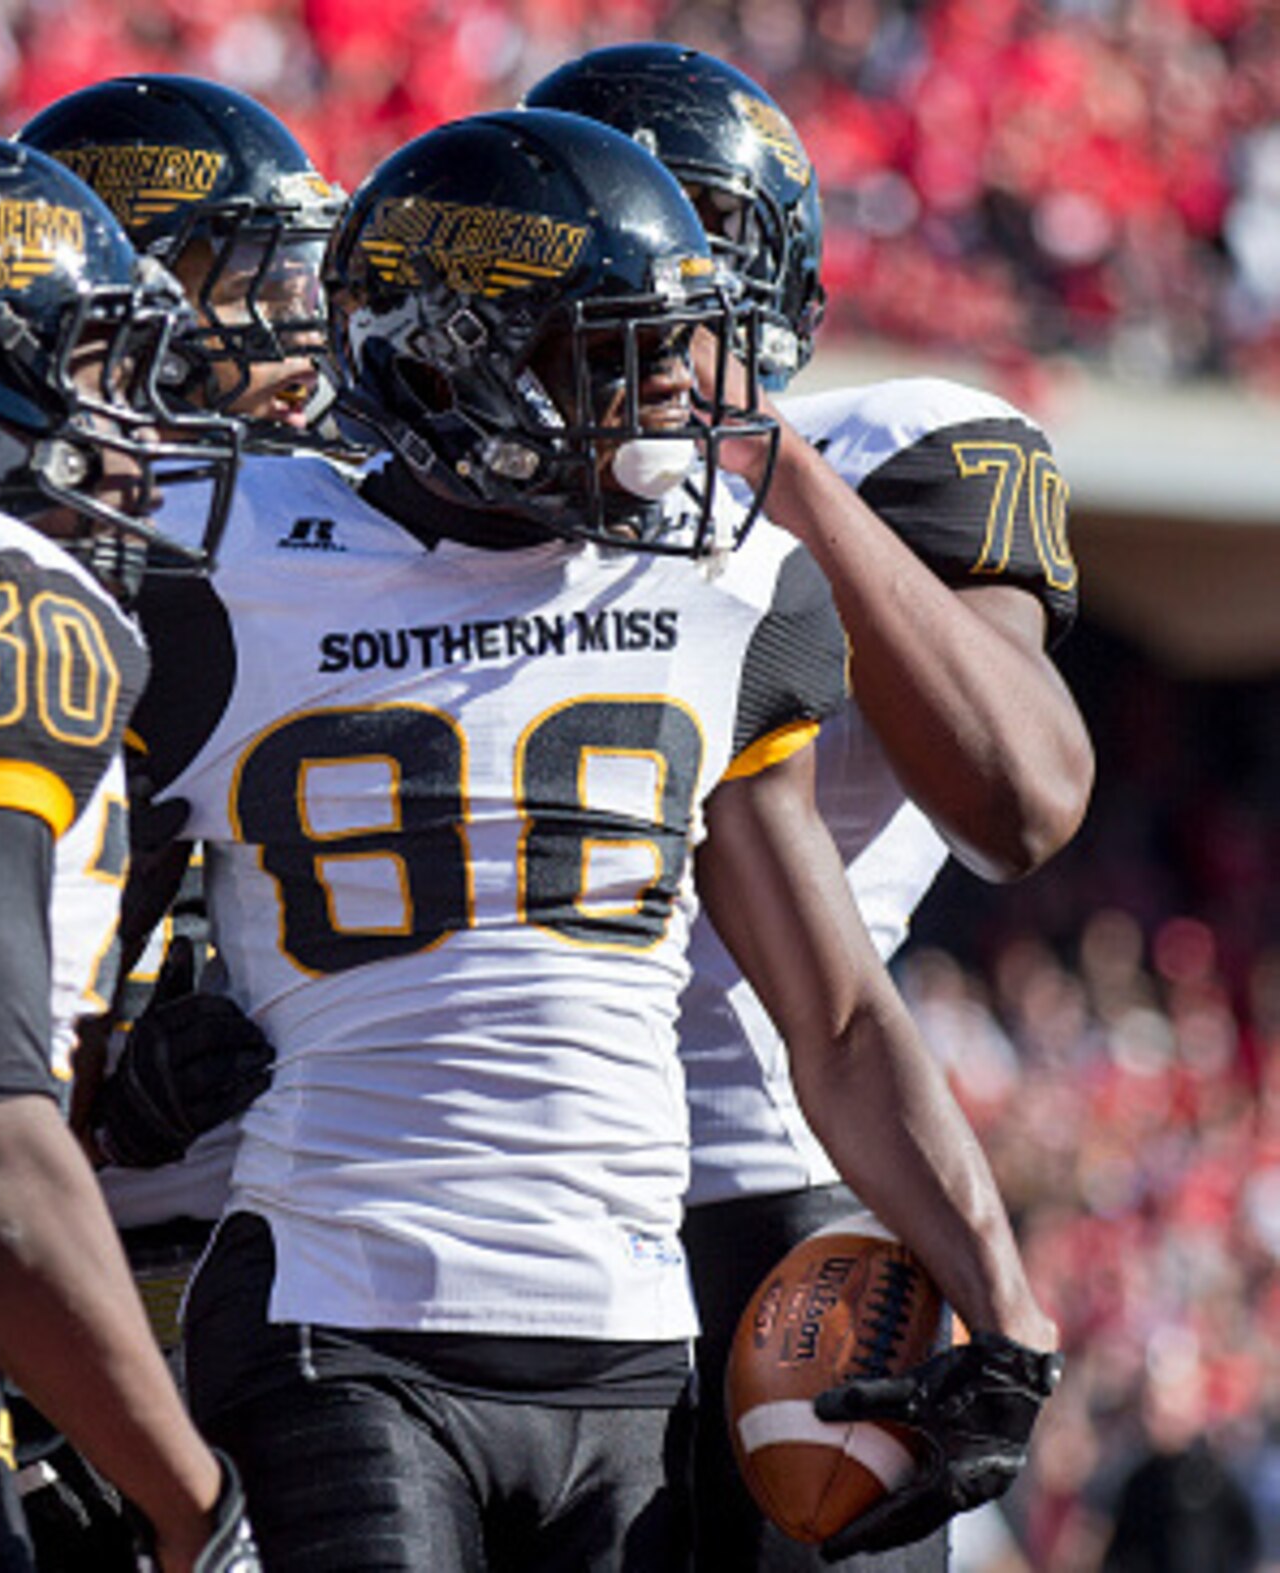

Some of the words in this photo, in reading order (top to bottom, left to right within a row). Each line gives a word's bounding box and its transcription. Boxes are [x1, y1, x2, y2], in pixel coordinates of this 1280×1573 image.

[951, 440, 1078, 592] 70
[317, 615, 568, 673] SOUTHERN
[573, 609, 678, 653] MISS
[229, 693, 705, 979] 88
